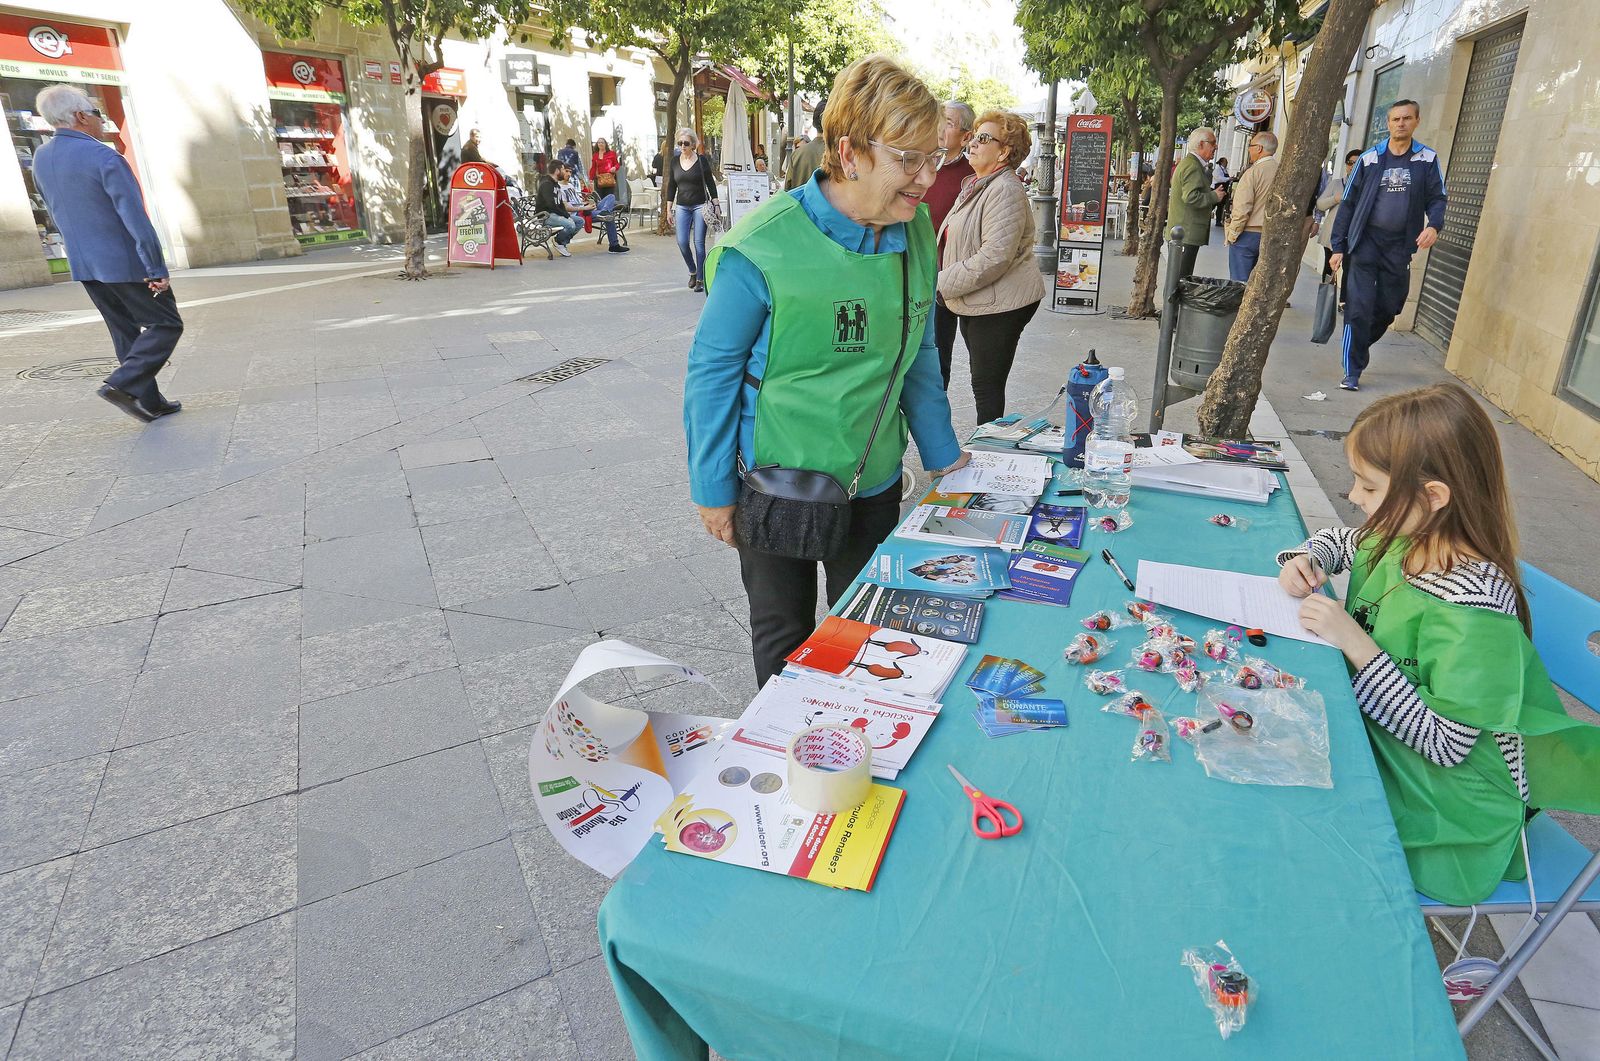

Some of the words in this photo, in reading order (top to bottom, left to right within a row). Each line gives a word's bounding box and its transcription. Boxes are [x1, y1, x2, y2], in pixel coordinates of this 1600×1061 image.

[1077, 119, 1103, 129] Coca-Cola
[460, 227, 482, 236] EFECTIVO
[1003, 703, 1046, 711] DONANTE
[572, 815, 608, 838] Mundial
[754, 804, 769, 867] www.alcer.org
[804, 824, 821, 847] doctor
[818, 825, 828, 837] tus
[807, 837, 822, 859] dudas
[828, 830, 852, 874] Renales?
